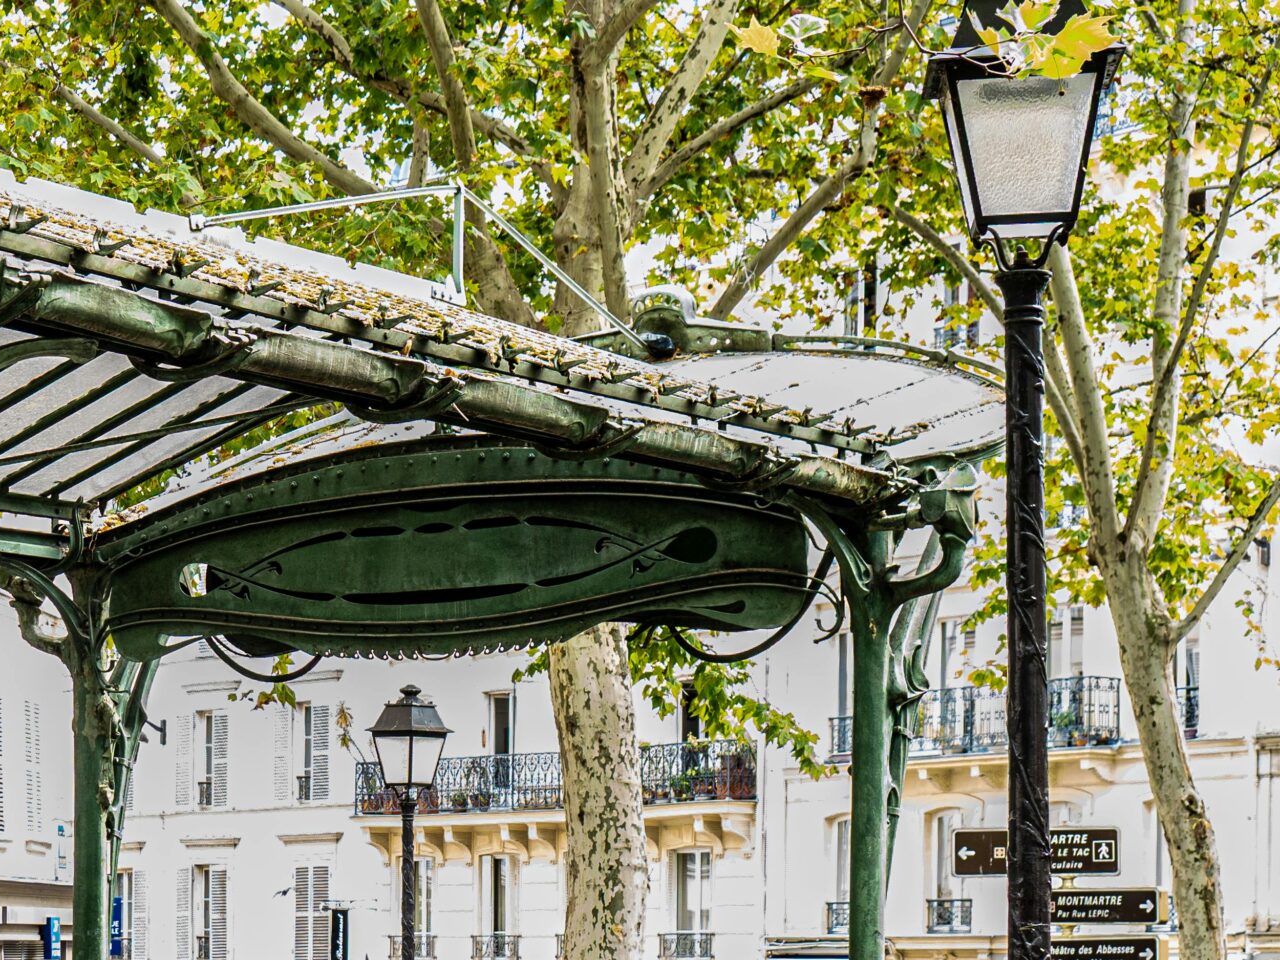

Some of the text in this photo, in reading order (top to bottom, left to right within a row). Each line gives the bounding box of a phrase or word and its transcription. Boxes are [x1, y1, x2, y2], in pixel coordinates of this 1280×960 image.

[1048, 834, 1089, 844] ARTRE
[1057, 847, 1069, 857] LE
[1071, 847, 1091, 857] TAC
[1051, 861, 1083, 869] culaire
[1057, 895, 1123, 906] MONTMARTRE
[1056, 909, 1110, 918] Par Rue LEPIC
[1050, 943, 1136, 955] héâtre des Abbesses
